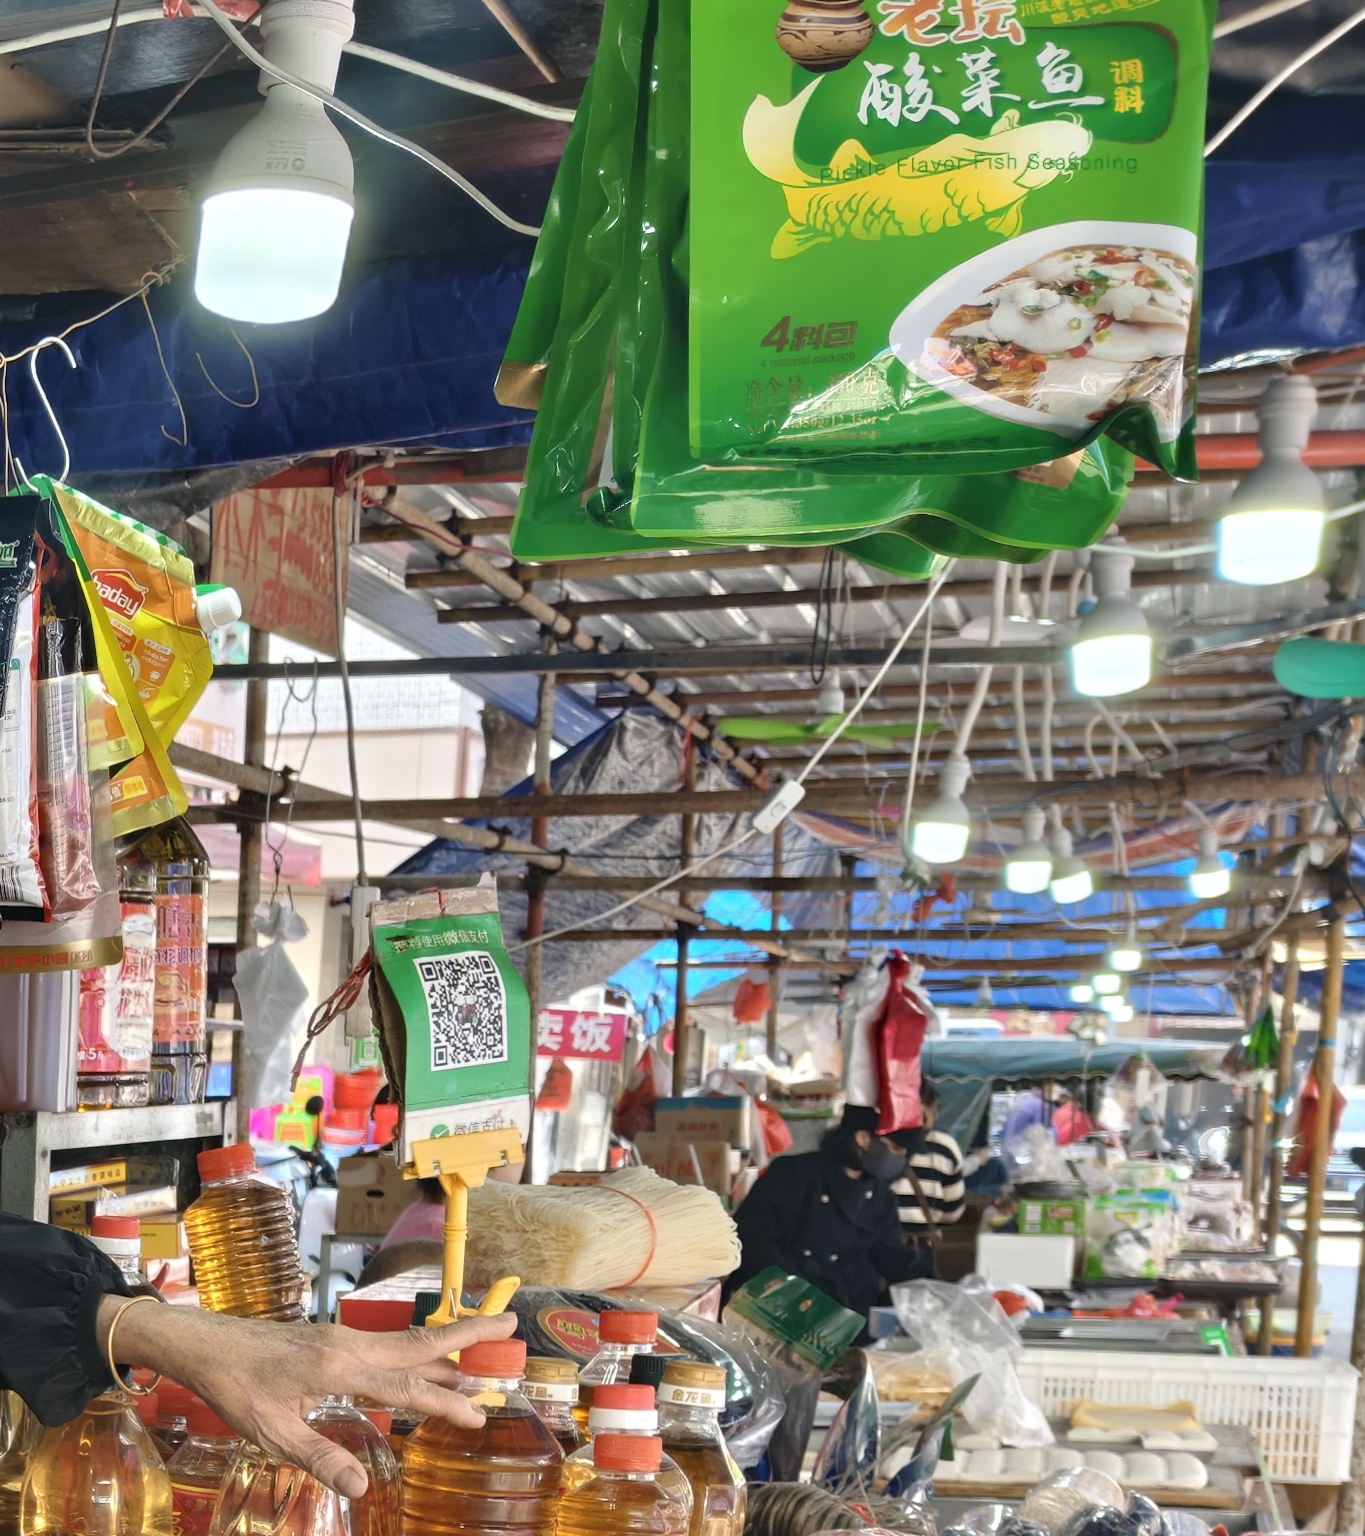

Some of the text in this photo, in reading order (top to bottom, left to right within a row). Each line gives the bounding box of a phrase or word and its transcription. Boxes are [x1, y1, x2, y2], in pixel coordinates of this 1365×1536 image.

[857, 42, 1106, 127] 酸菜鱼
[1109, 59, 1146, 114] 调料
[819, 152, 1138, 184] Pickle Flavor Fish Seasoning
[760, 315, 859, 353] 4料包
[93, 575, 140, 616] haday
[537, 1011, 614, 1055] 卖饭
[671, 1388, 712, 1405] 金龙鱼
